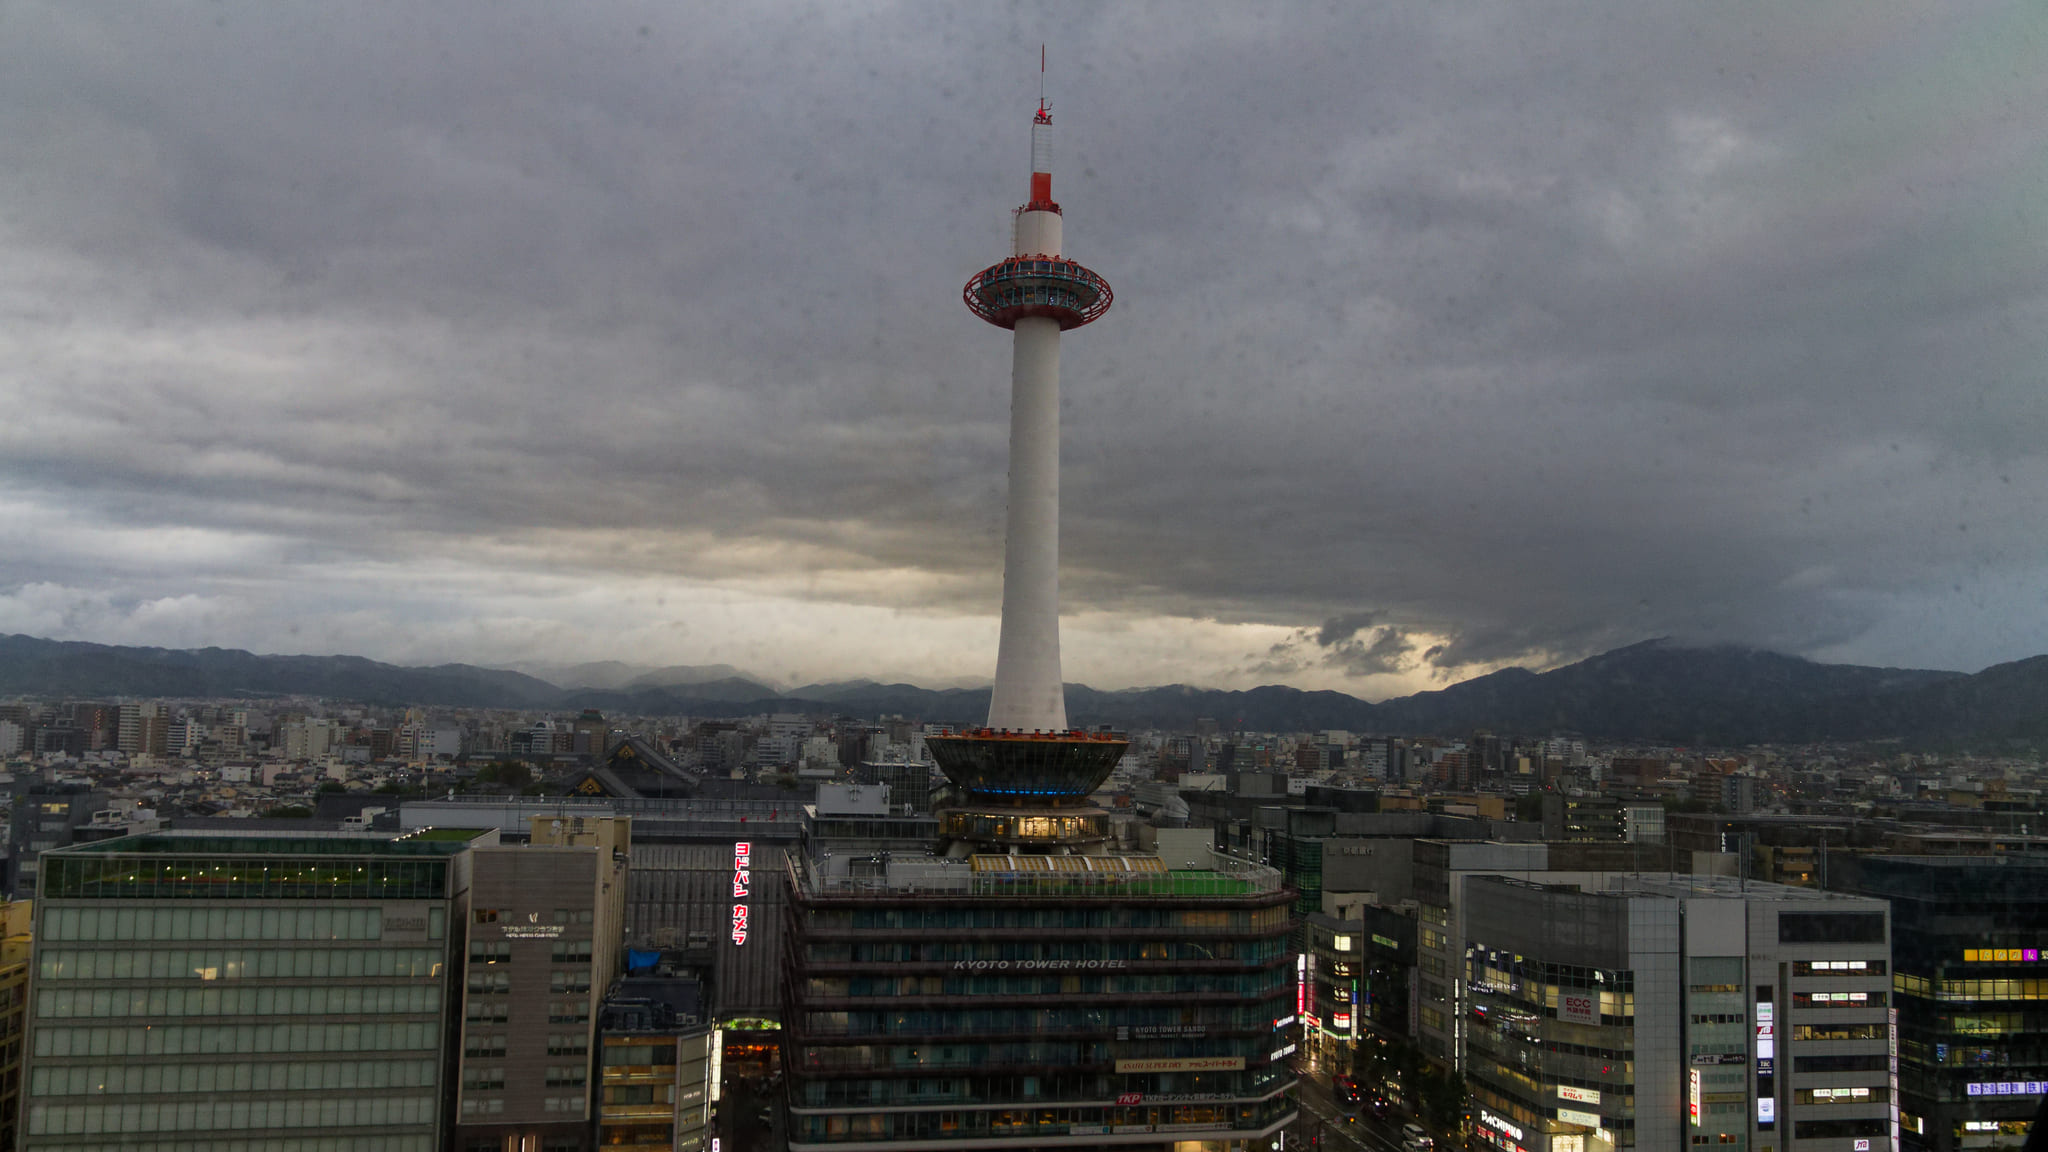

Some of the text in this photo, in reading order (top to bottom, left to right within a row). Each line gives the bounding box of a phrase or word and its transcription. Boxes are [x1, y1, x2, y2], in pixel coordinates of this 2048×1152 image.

[732, 841, 751, 946] ヨドバシ カメラ
[953, 959, 1127, 970] KYOTO TOWER HOTEL
[1566, 997, 1592, 1008] ECC
[1117, 1093, 1141, 1104] TKP
[1481, 1109, 1523, 1141] PACHINKO
